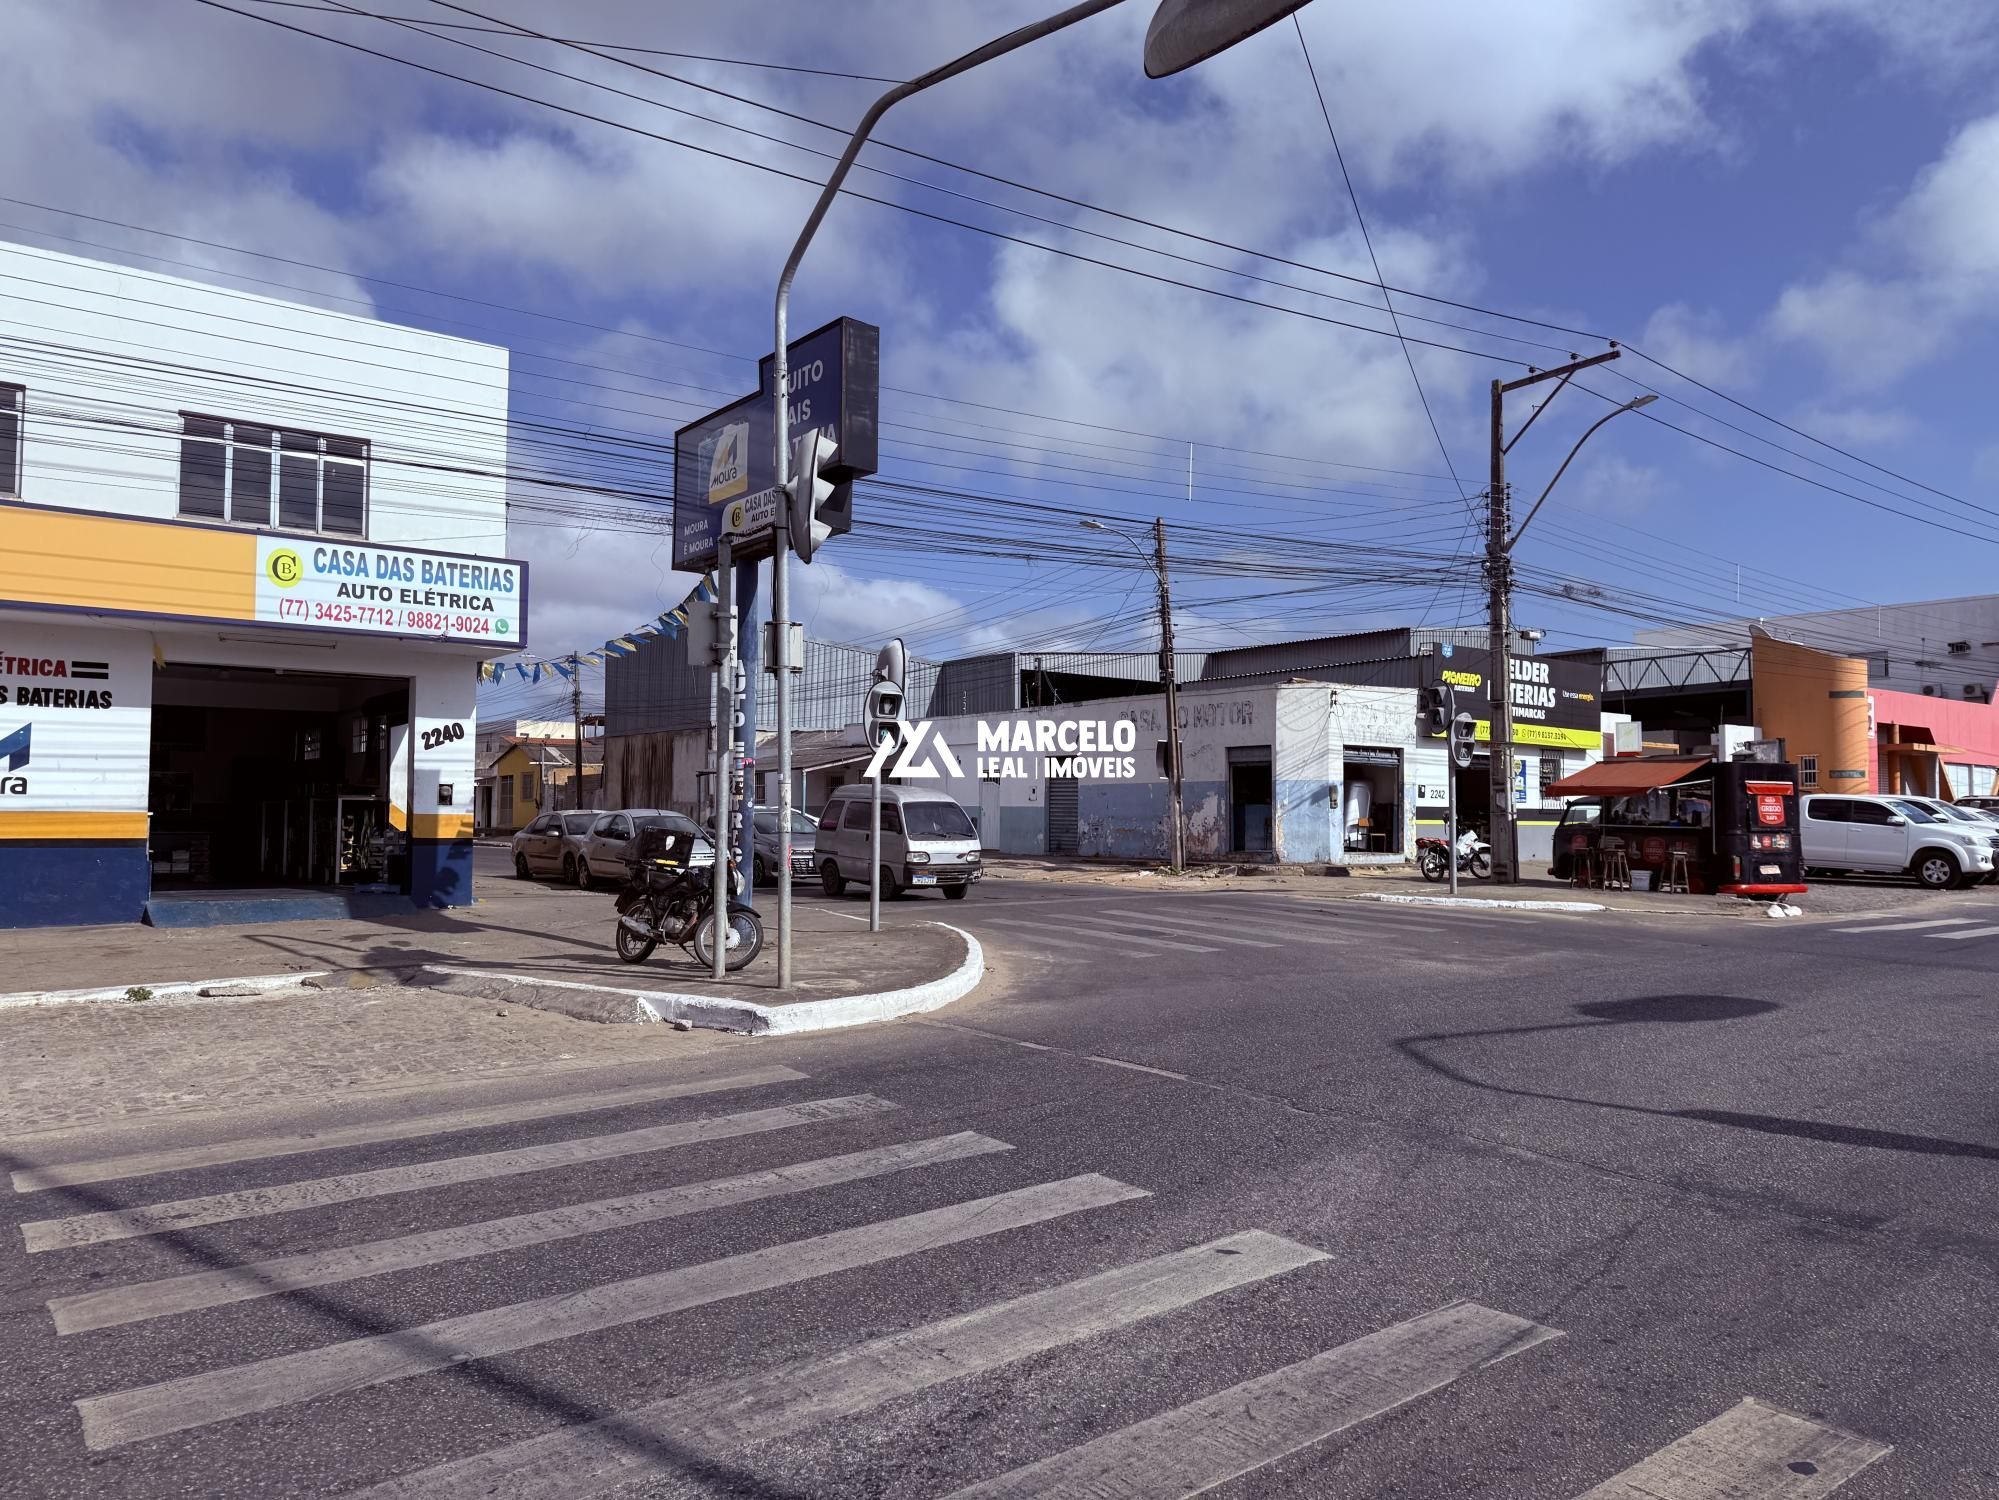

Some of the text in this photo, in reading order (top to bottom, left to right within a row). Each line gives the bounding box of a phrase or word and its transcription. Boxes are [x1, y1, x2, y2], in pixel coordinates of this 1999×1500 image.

[788, 360, 824, 394] UITO
[744, 493, 762, 513] CASA
[684, 520, 708, 536] MOURA
[751, 512, 769, 523] AUTO
[684, 537, 713, 555] É MOURA
[313, 547, 514, 593] CASA DAS BATERIAS
[337, 582, 494, 612] AUTO ELÉTRICA
[279, 597, 310, 622] (77)
[315, 602, 394, 626] 3425-7712
[407, 610, 490, 635] 98821-9024
[0, 651, 68, 678] TRICA
[1509, 659, 1549, 684] ELDER
[16, 686, 113, 709] BATERIAS
[421, 722, 466, 750] 2240
[1430, 789, 1446, 799] 2242
